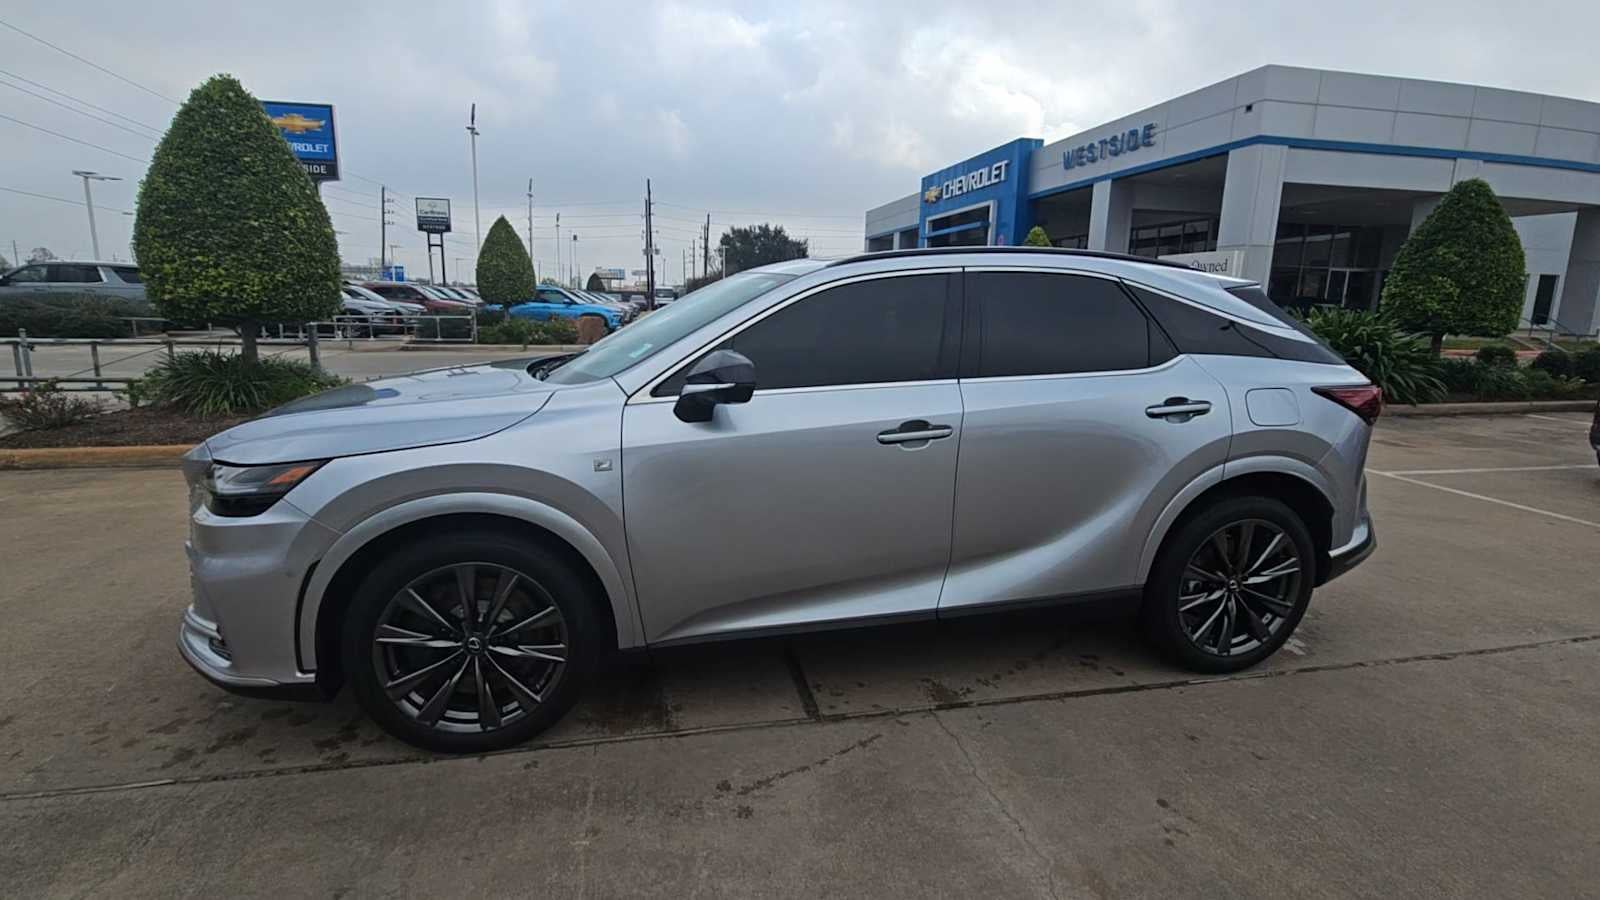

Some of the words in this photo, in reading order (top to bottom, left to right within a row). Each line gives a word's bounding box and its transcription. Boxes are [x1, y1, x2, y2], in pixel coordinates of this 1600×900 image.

[287, 142, 329, 153] VROLET
[1063, 122, 1157, 170] WESTSIDE
[303, 164, 328, 174] SIDE
[942, 159, 1010, 200] CHEVROLET
